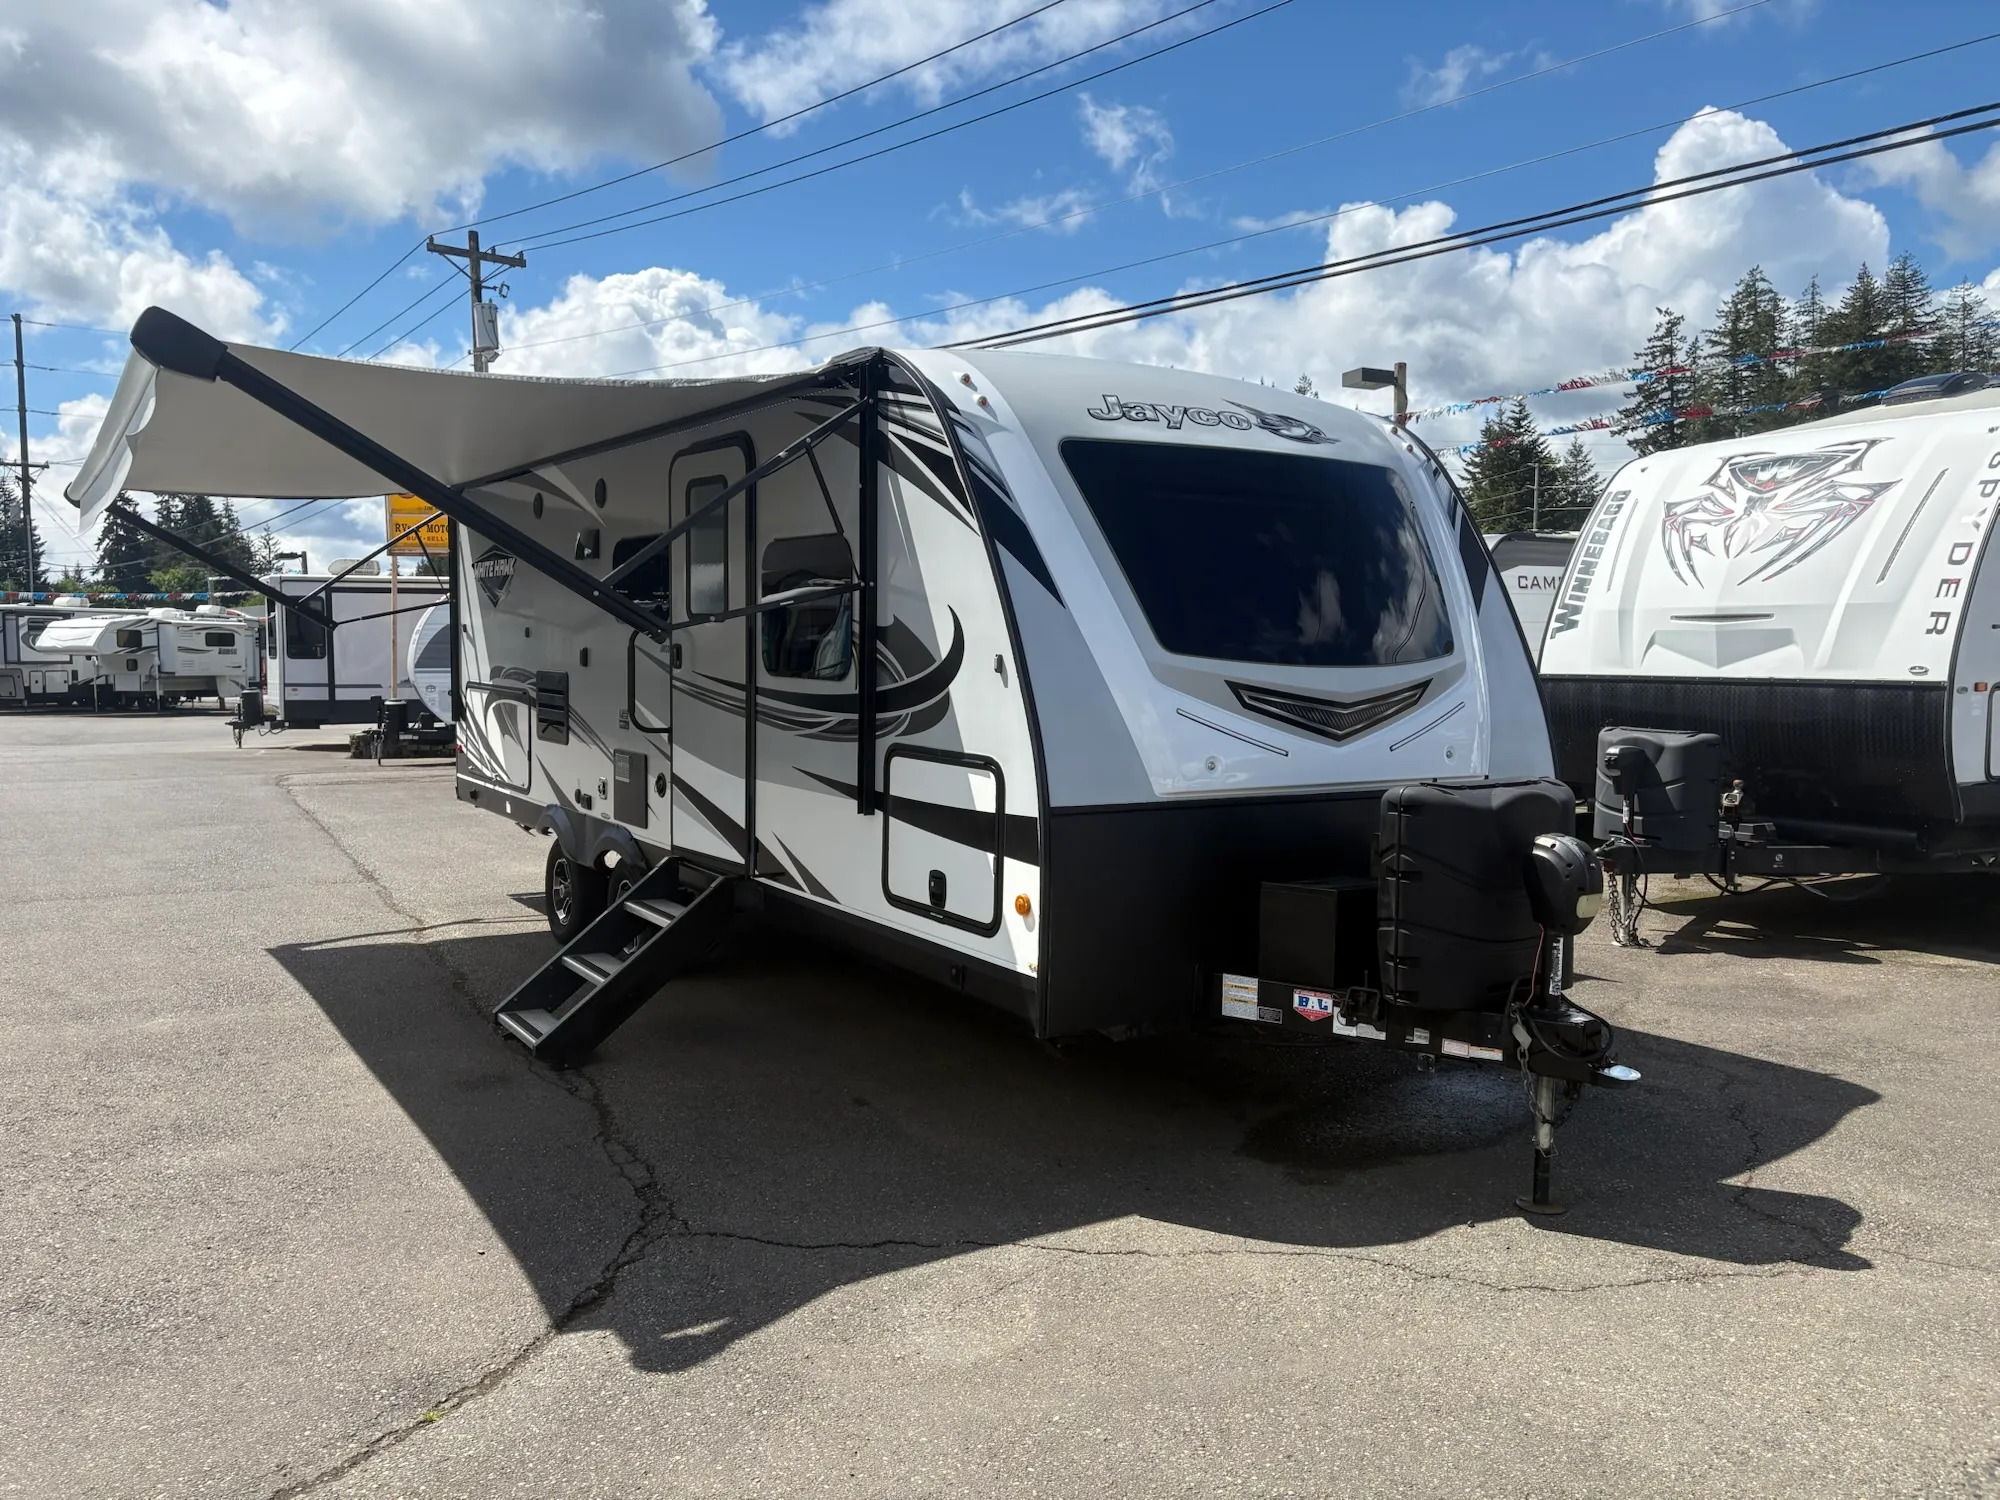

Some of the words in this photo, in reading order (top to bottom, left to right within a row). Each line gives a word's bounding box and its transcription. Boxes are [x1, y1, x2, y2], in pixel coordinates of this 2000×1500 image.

[1087, 394, 1253, 430] Jayco
[1518, 575, 1562, 589] CAM
[1550, 490, 1632, 639] WINNEBAGO
